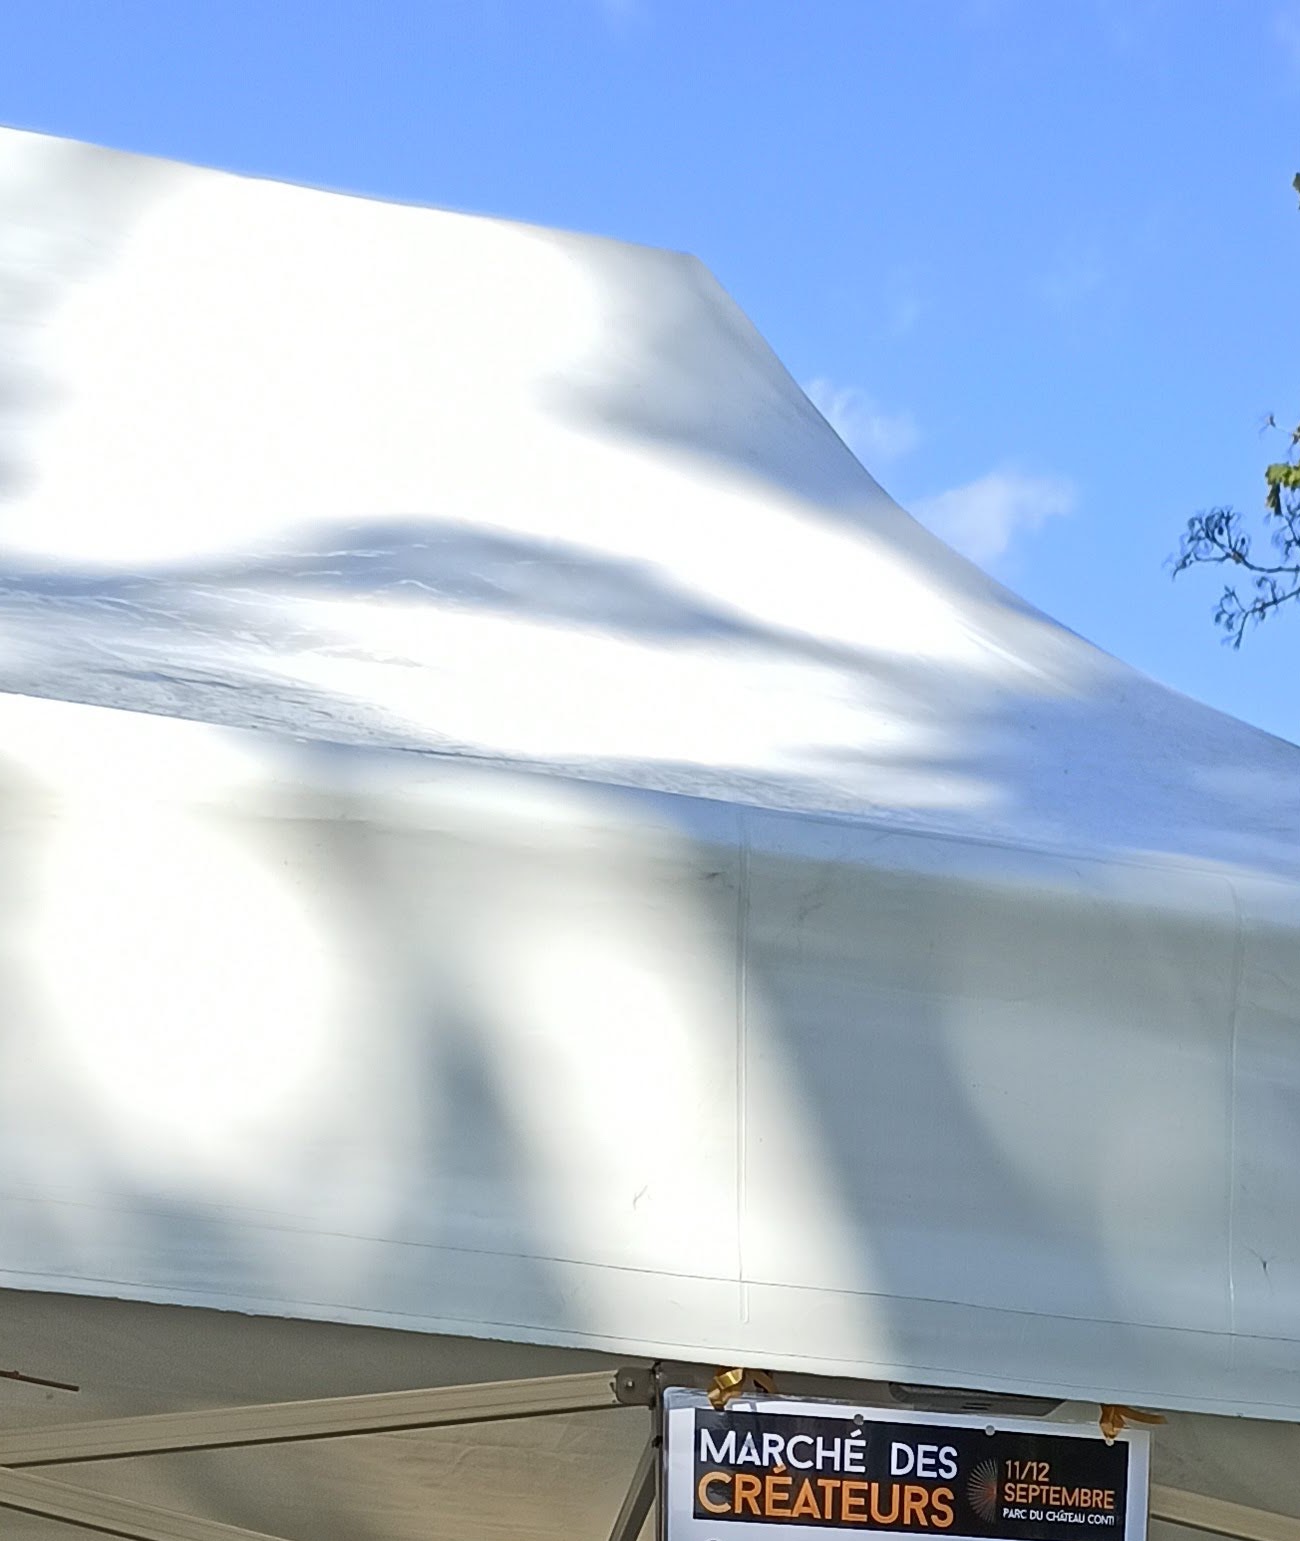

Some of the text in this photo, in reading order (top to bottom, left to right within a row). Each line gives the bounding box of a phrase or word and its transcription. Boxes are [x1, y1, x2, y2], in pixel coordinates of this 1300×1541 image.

[700, 1429, 958, 1480] MARCHÉ DES
[1005, 1460, 1050, 1482] 11/12
[698, 1464, 955, 1528] CRÉATEURS
[1004, 1483, 1115, 1510] SEPTEMBRE
[1003, 1508, 1115, 1526] PARC DU CHÂTEAU CONTI
